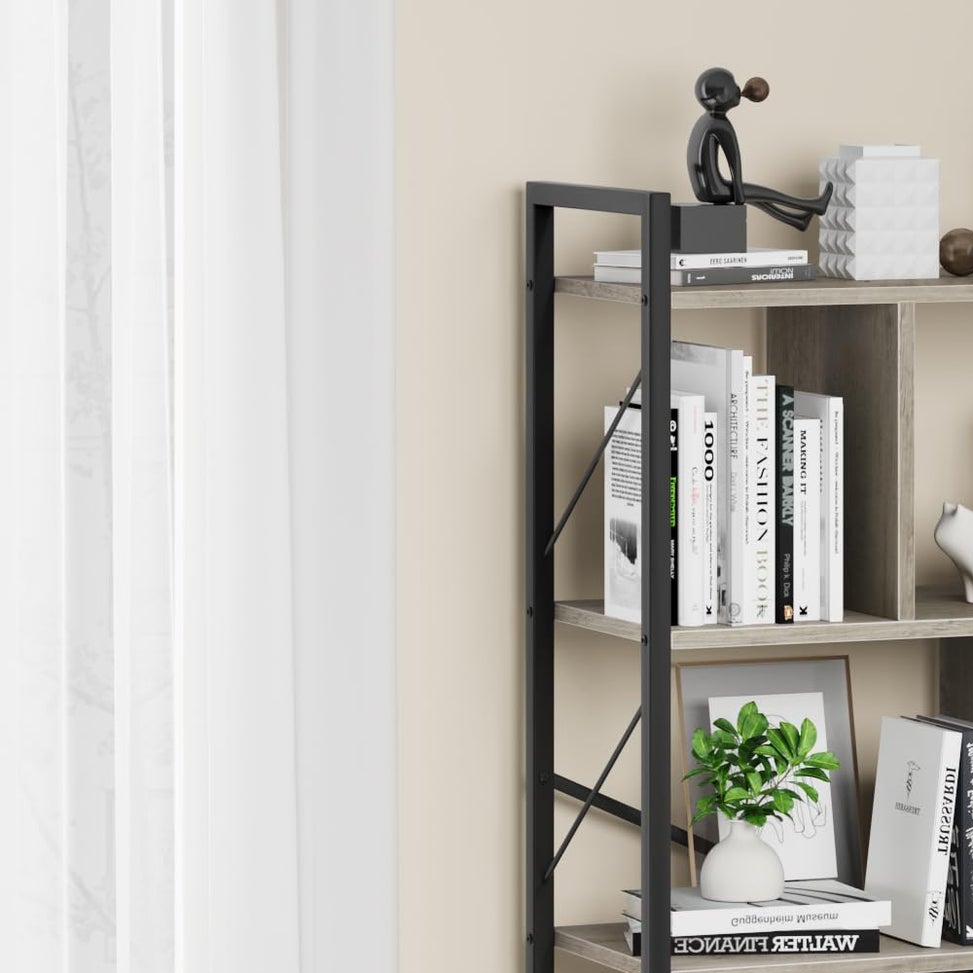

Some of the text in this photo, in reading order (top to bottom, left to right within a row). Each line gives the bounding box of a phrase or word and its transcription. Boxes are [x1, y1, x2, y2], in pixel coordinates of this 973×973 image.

[751, 273, 794, 281] INTERIORS
[730, 393, 738, 460] ARCHITECTURE
[782, 409, 794, 472] SCANNER
[704, 420, 714, 482] 1000
[756, 380, 769, 618] THE FASHION BOOK
[800, 482, 807, 495] IT
[782, 553, 791, 572] Philip
[782, 582, 791, 598] Dick
